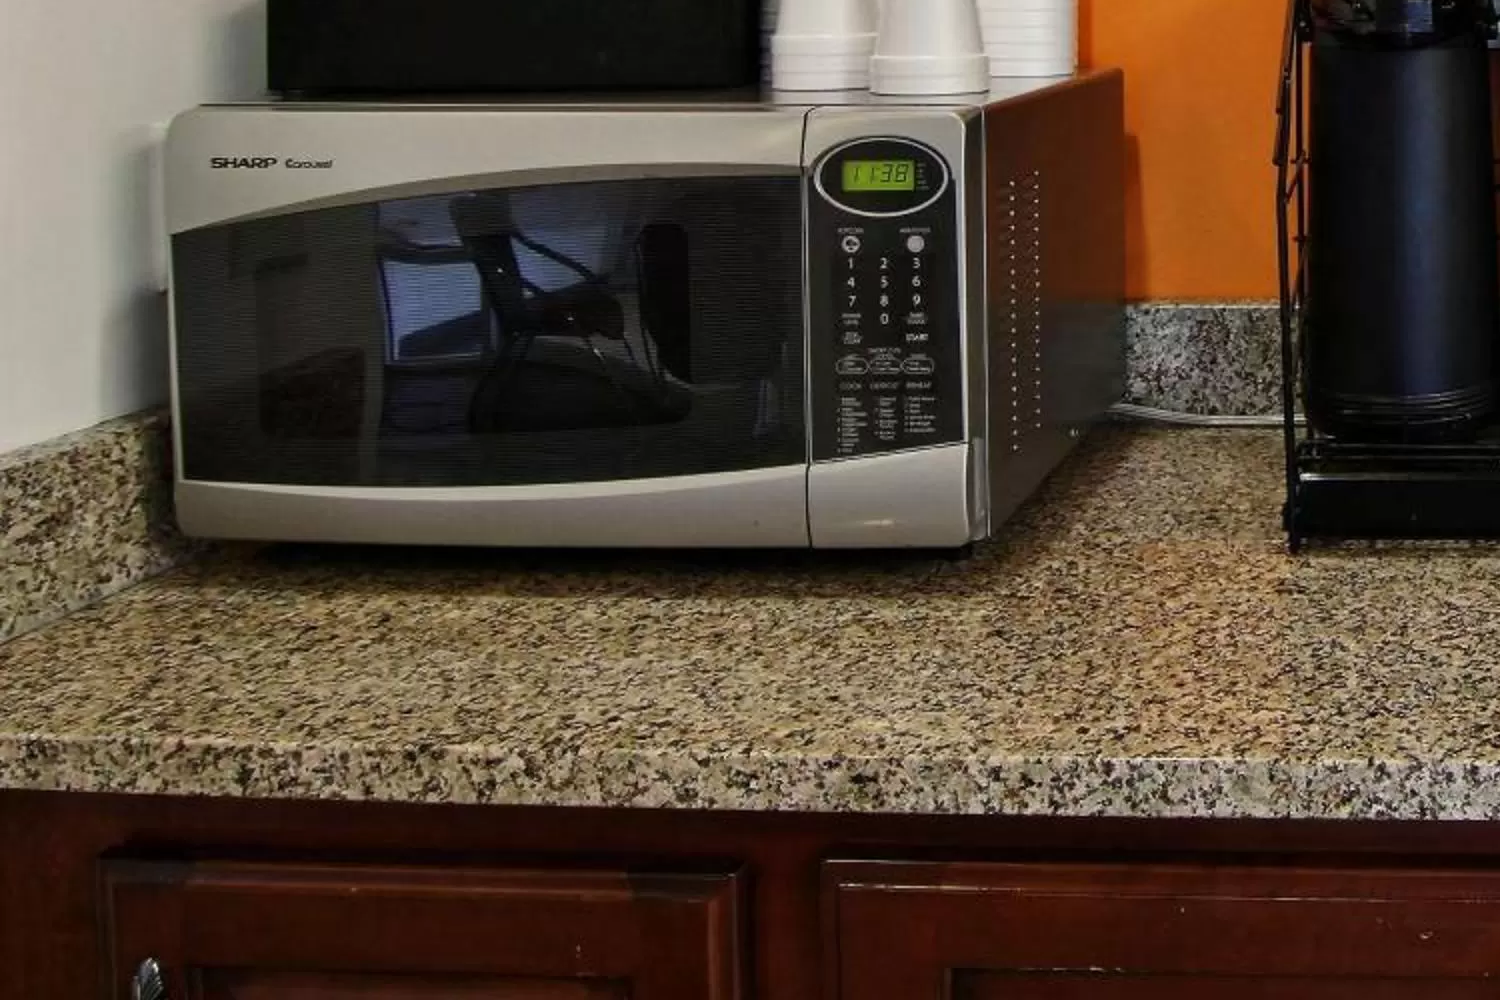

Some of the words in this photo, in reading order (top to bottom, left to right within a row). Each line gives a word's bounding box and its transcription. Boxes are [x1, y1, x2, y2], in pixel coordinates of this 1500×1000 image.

[210, 157, 278, 169] SHARP
[847, 257, 854, 269] 1
[880, 257, 888, 269] 2
[912, 257, 921, 269] 3
[847, 276, 856, 288] 4
[880, 275, 889, 289] 5
[911, 275, 921, 287] 6
[848, 294, 857, 307] 7
[880, 294, 889, 307] 8
[912, 293, 921, 307] 9
[880, 313, 889, 325] 0
